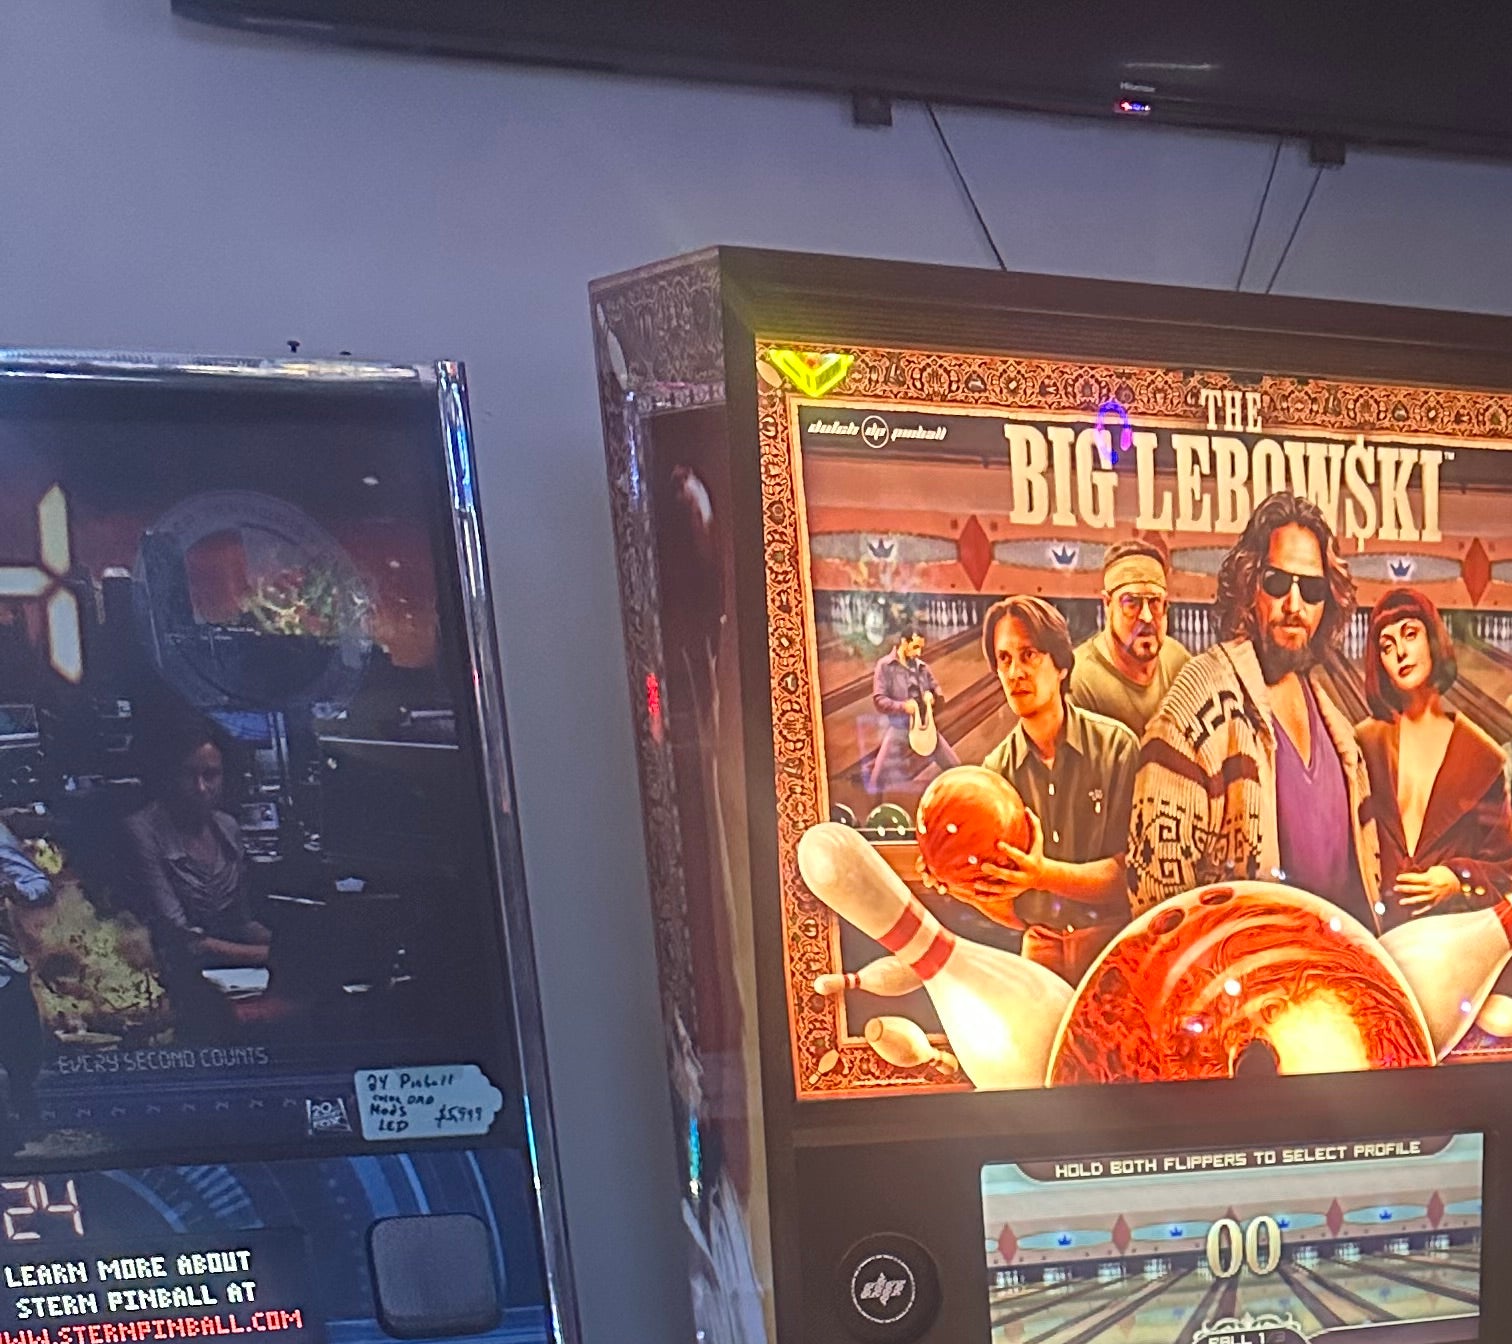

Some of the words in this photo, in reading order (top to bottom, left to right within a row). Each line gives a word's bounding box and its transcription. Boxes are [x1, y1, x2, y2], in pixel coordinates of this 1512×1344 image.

[1200, 389, 1263, 434] THE
[1004, 423, 1118, 528] BIG
[57, 1053, 119, 1075] EVERY
[124, 1049, 196, 1072] SECOND
[200, 1046, 269, 1068] COUNTS
[1056, 1160, 1104, 1179] HOLD
[1109, 1157, 1159, 1176] BOTH
[1163, 1151, 1248, 1172] FLIPPERS
[1253, 1149, 1276, 1167] TO
[1282, 1145, 1348, 1164] SELECT
[1353, 1140, 1421, 1160] PROFILE
[1, 1179, 84, 1241] 24
[1205, 1215, 1282, 1280] 00
[3, 1261, 88, 1288] LEARN
[97, 1256, 167, 1281] MORE
[176, 1250, 251, 1276] ABOUT
[15, 1293, 98, 1319] STERN
[107, 1285, 217, 1312] PINBALL
[226, 1281, 257, 1303] AT
